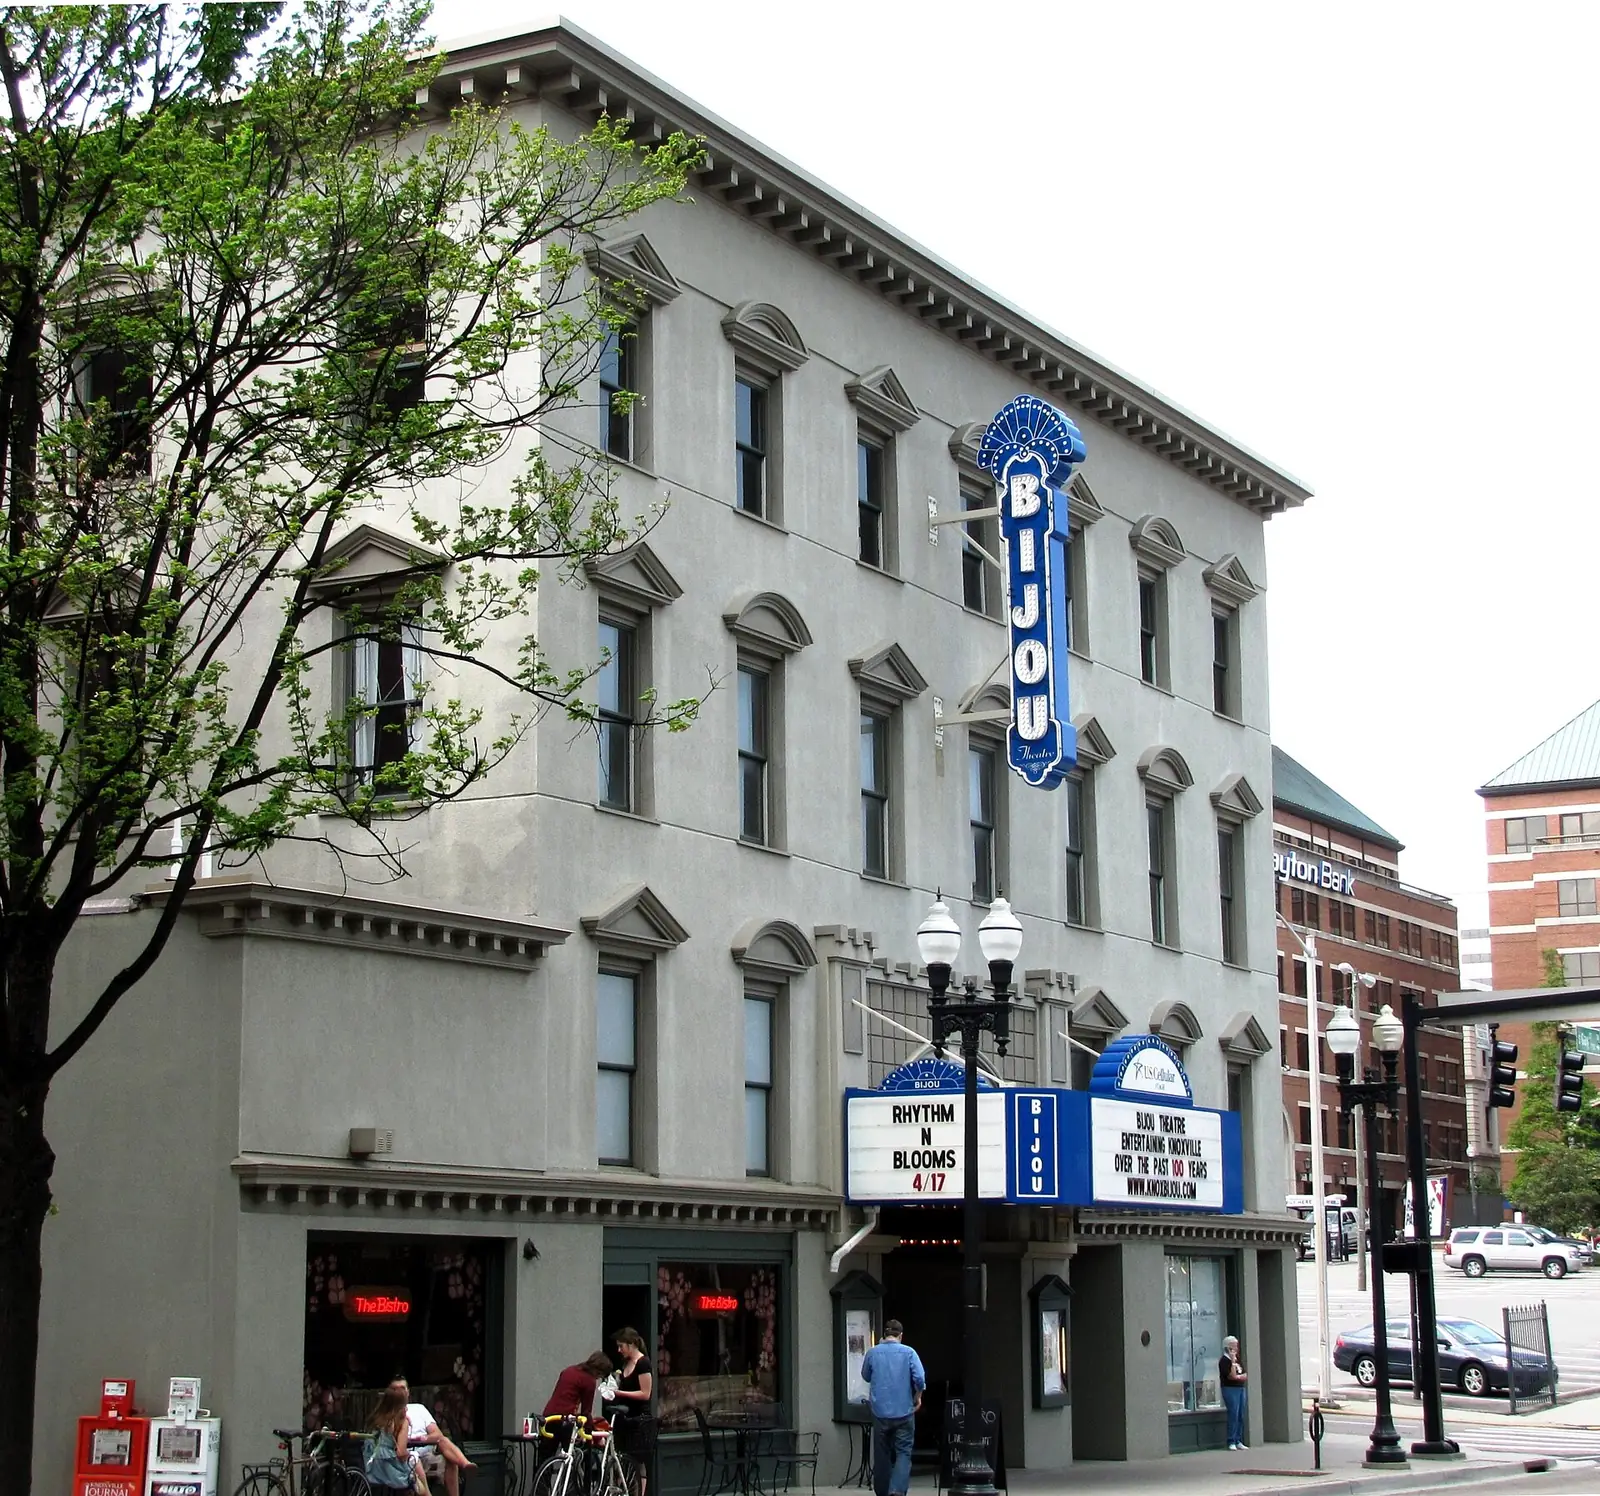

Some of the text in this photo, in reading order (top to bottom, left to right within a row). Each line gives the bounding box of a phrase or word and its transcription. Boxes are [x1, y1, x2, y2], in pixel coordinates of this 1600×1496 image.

[1010, 473, 1048, 741] BIJOU
[1321, 861, 1355, 896] Bank
[914, 1081, 940, 1089] BIJOU
[892, 1103, 955, 1124] RHYTHM
[1136, 1111, 1186, 1135] BIJOU THEATRE
[921, 1127, 932, 1146] N
[1031, 1099, 1043, 1193] BIJOU
[1121, 1131, 1202, 1157] ENTERTAINING KNOXVILLE
[893, 1149, 956, 1169] BLOOMS
[1114, 1154, 1208, 1179] OVER THE PAST 100 YEARS
[912, 1173, 946, 1192] 4/17
[1127, 1177, 1197, 1200] WWW.KNOXBIJOU.COM
[90, 1481, 123, 1489] KNOXVILLE
[157, 1484, 197, 1495] AUTO
